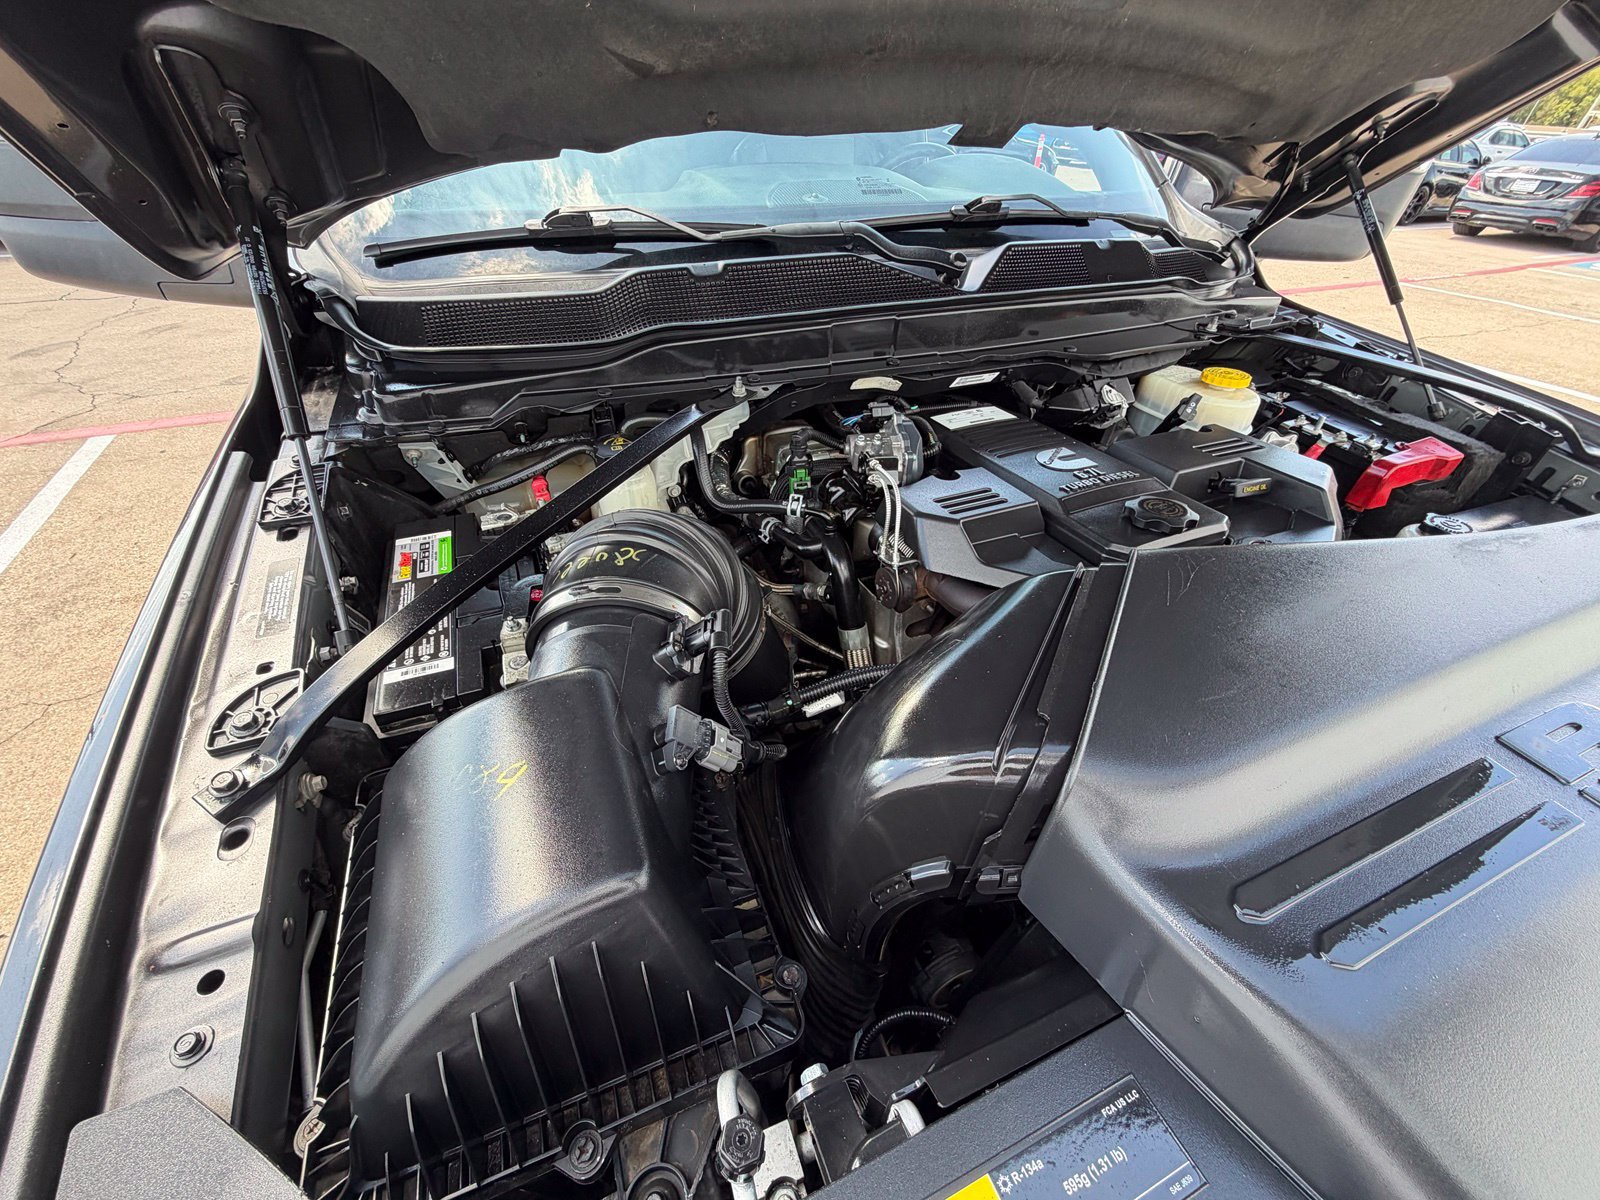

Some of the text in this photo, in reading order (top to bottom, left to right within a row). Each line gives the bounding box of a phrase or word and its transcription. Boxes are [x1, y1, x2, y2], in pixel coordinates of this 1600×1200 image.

[257, 244, 273, 290] STABILUS
[1060, 470, 1140, 493] TURBO DIESEL
[1243, 485, 1260, 493] ENGINE
[1101, 1089, 1140, 1118] FCA US LLC
[1011, 1157, 1045, 1185] R-134a
[1062, 1146, 1128, 1196] 595g (1.31 lb)
[1169, 1183, 1181, 1195] SAE
